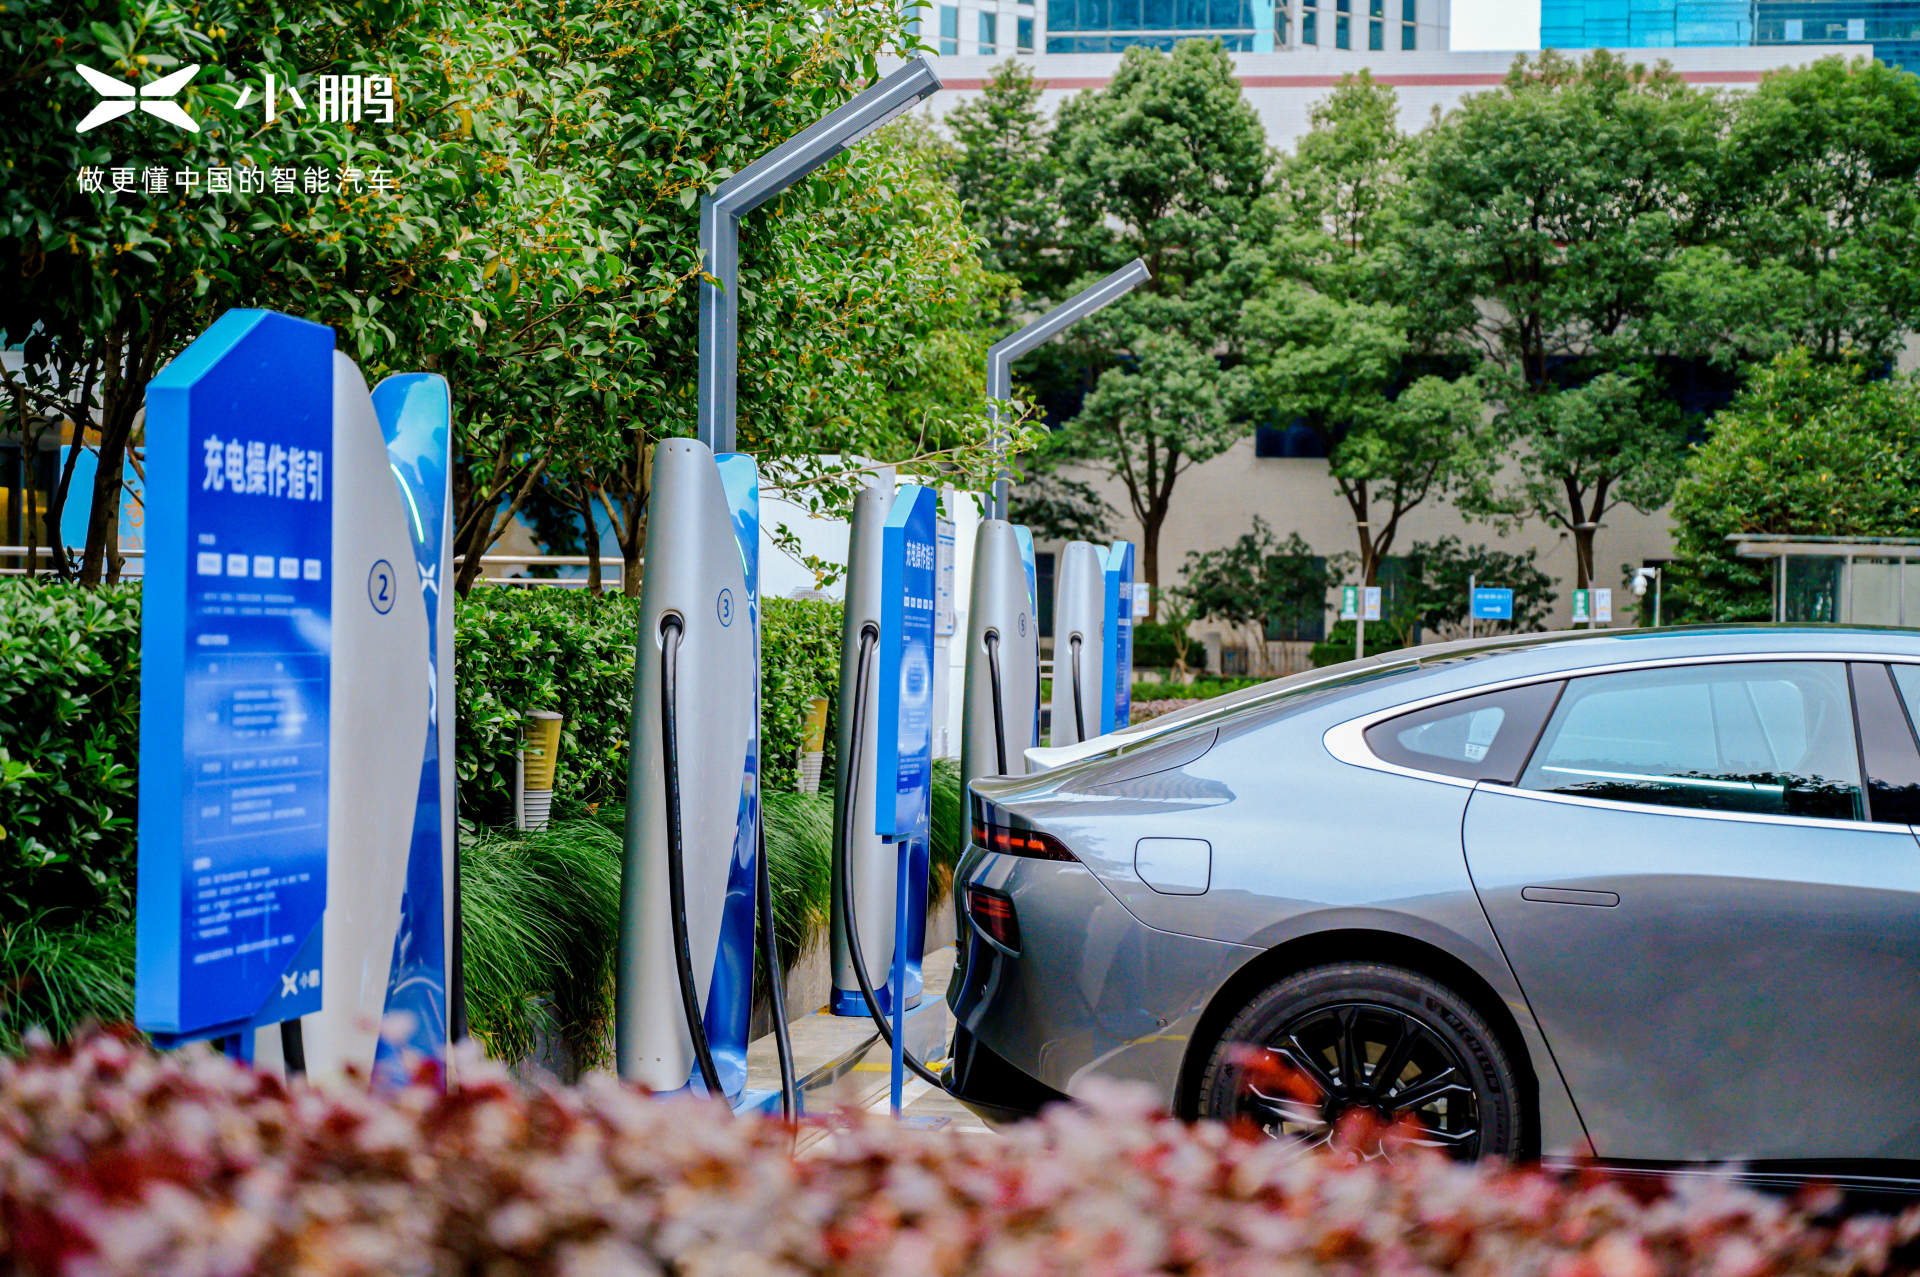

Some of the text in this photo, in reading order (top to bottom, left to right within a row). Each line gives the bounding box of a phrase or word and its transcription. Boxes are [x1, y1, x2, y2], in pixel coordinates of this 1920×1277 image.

[203, 434, 323, 501] 充电操作指引
[378, 574, 388, 601] 2
